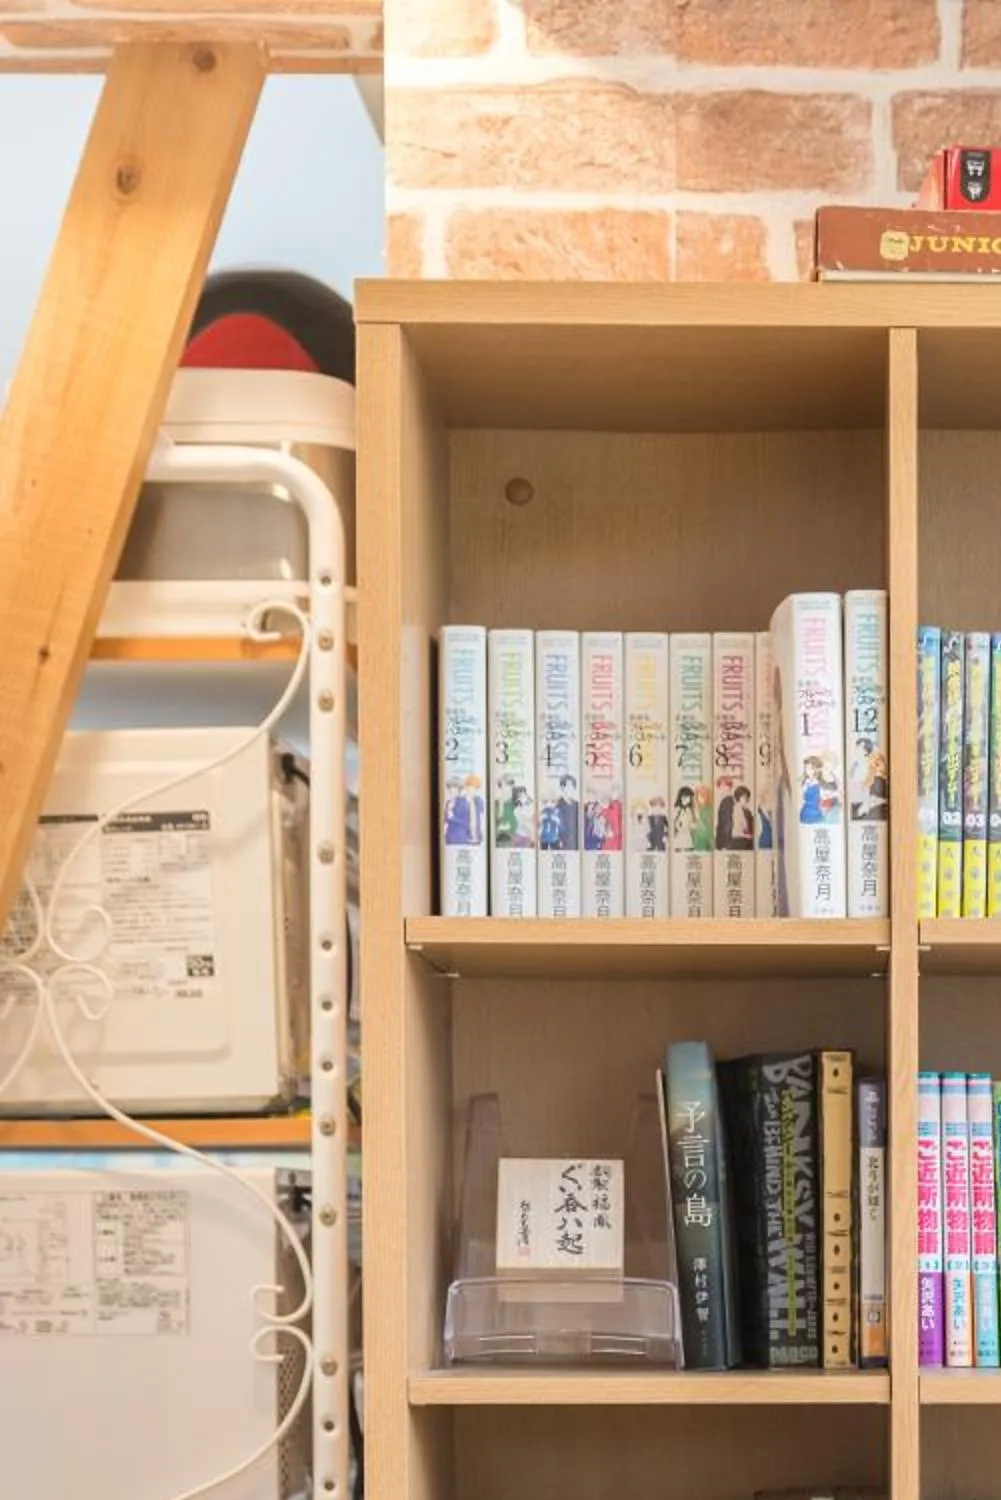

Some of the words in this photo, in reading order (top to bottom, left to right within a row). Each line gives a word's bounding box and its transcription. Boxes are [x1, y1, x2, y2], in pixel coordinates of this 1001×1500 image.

[546, 655, 569, 710] FRUITS
[592, 655, 613, 710] FRUITS
[681, 655, 703, 711] FRUITS
[722, 655, 744, 711] FRUITS
[801, 712, 811, 737] 1
[853, 708, 879, 733] 12
[446, 738, 459, 761] 2
[496, 741, 508, 764] 3
[629, 743, 642, 767] 6
[675, 744, 688, 767] 7
[965, 814, 985, 827] 03
